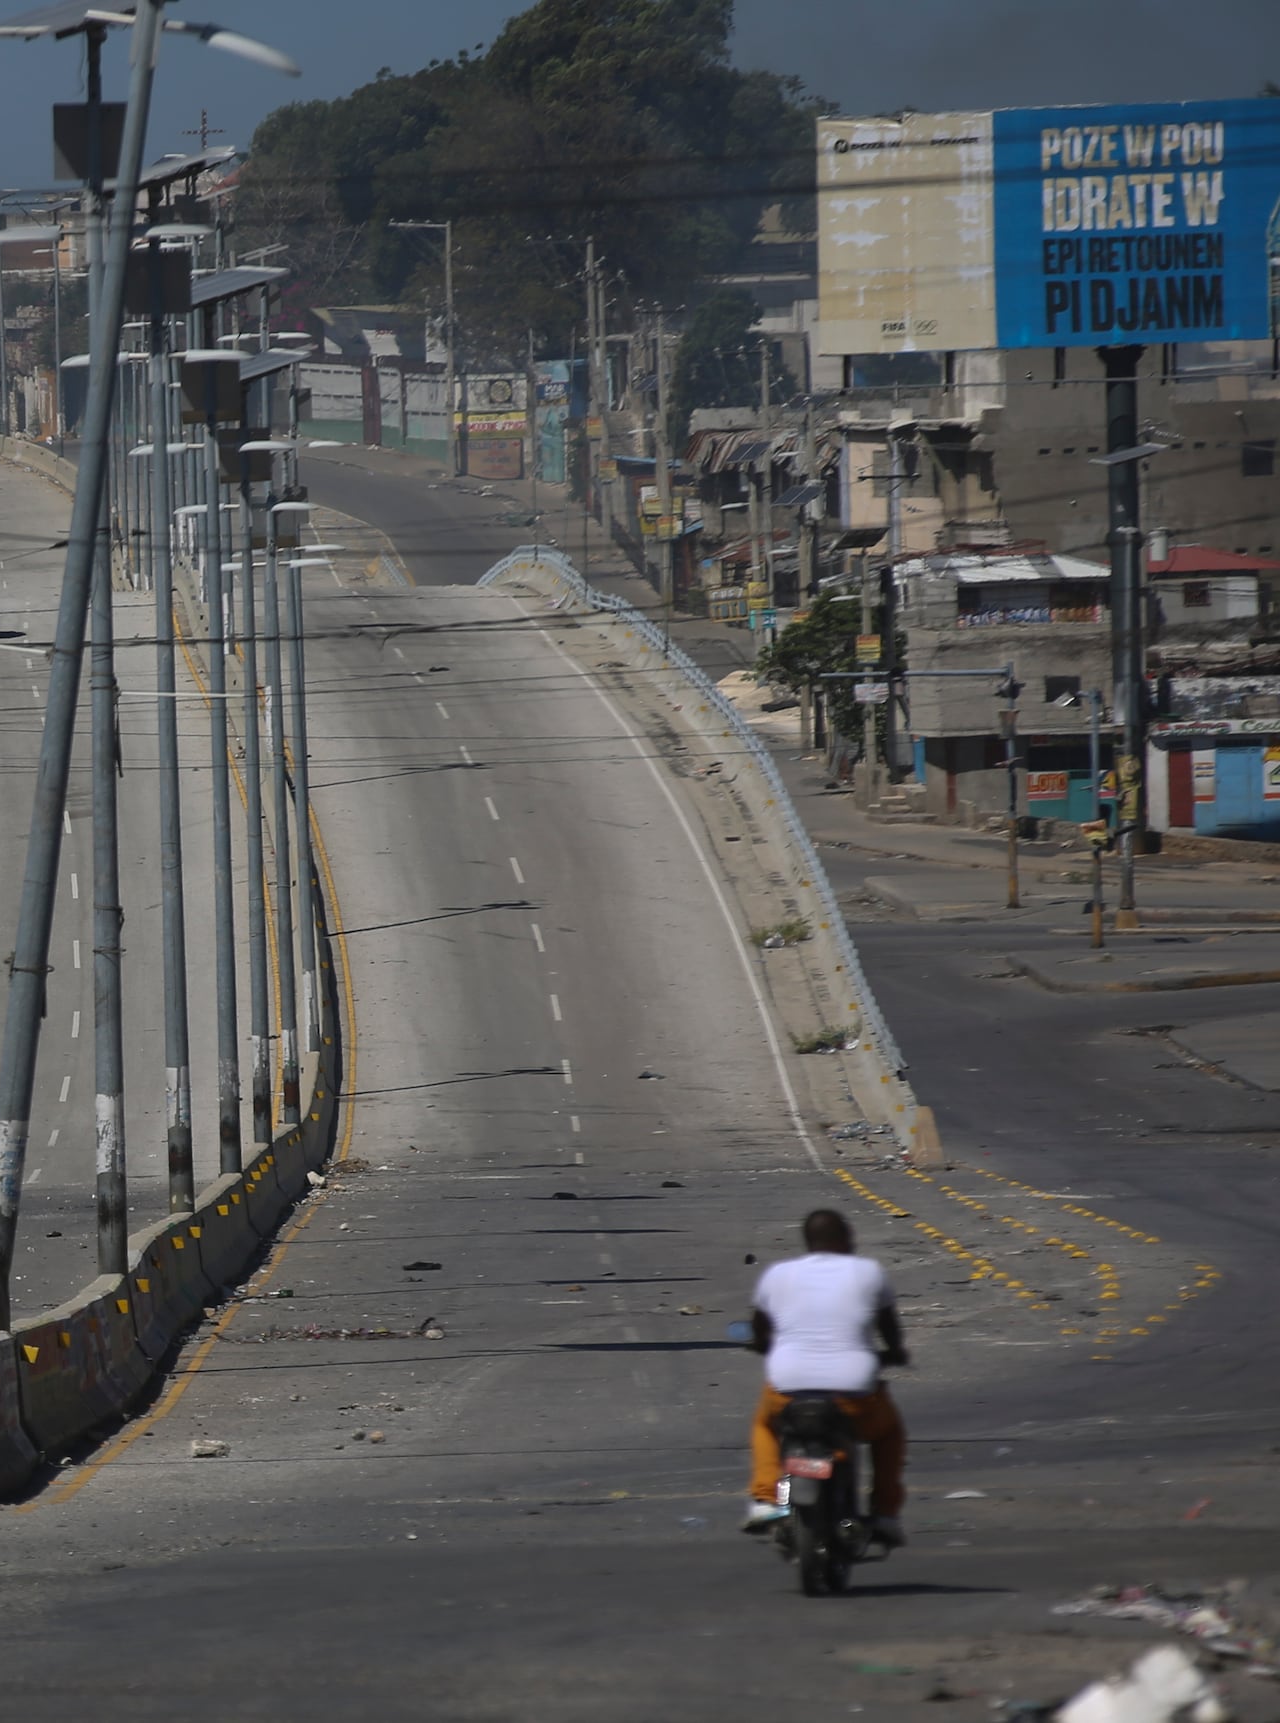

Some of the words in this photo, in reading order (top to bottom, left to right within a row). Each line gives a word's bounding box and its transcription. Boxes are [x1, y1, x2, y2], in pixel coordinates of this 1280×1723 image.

[1041, 125, 1119, 170] POZE
[1123, 124, 1155, 167] W
[1161, 122, 1224, 167] POU
[1042, 173, 1175, 232] IDRATE
[1180, 171, 1225, 226] W
[1043, 237, 1082, 275] EPI
[1088, 232, 1224, 273] RETOUNEN
[1045, 280, 1081, 333] PI
[1090, 275, 1224, 331] DJANM
[1026, 774, 1068, 792] LOTO
